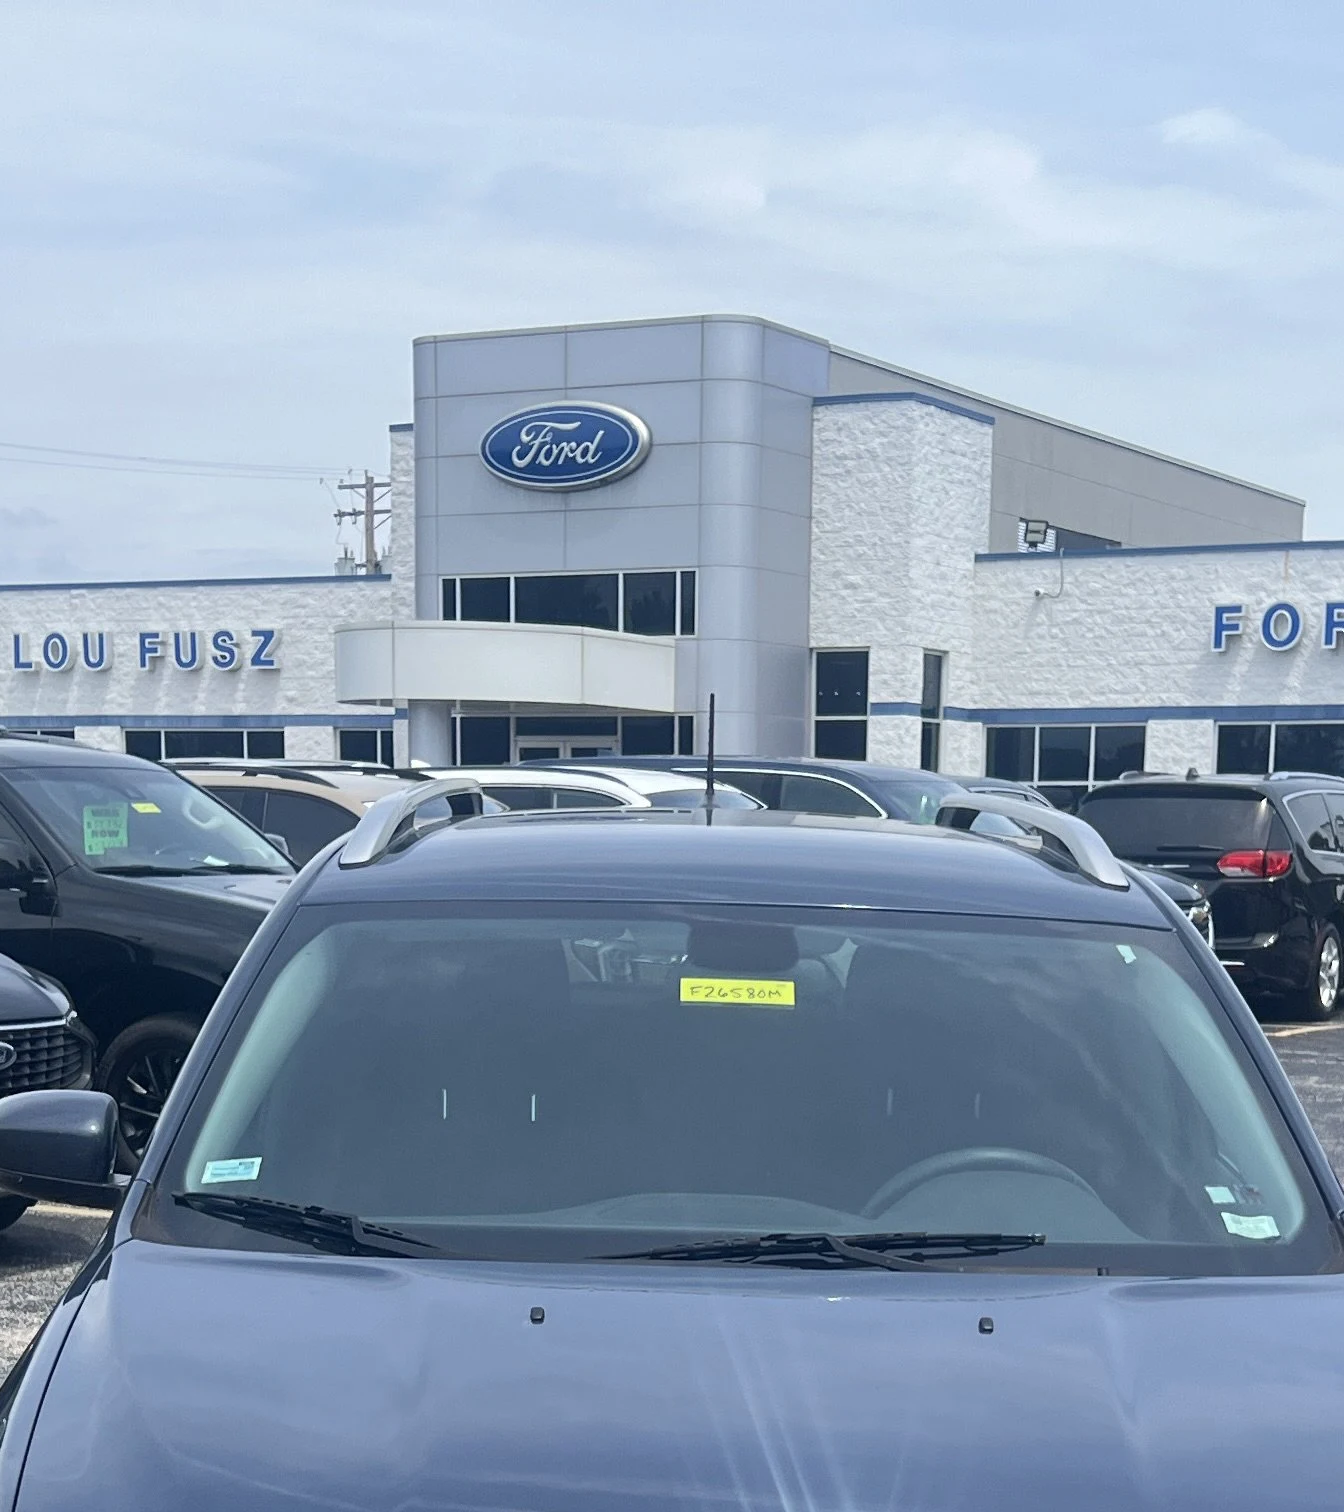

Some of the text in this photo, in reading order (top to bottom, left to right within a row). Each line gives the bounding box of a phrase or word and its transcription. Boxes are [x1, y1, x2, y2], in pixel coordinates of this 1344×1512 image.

[512, 421, 605, 468] Ford
[13, 629, 278, 671] LOU FUSZ
[689, 985, 782, 999] F26580M
